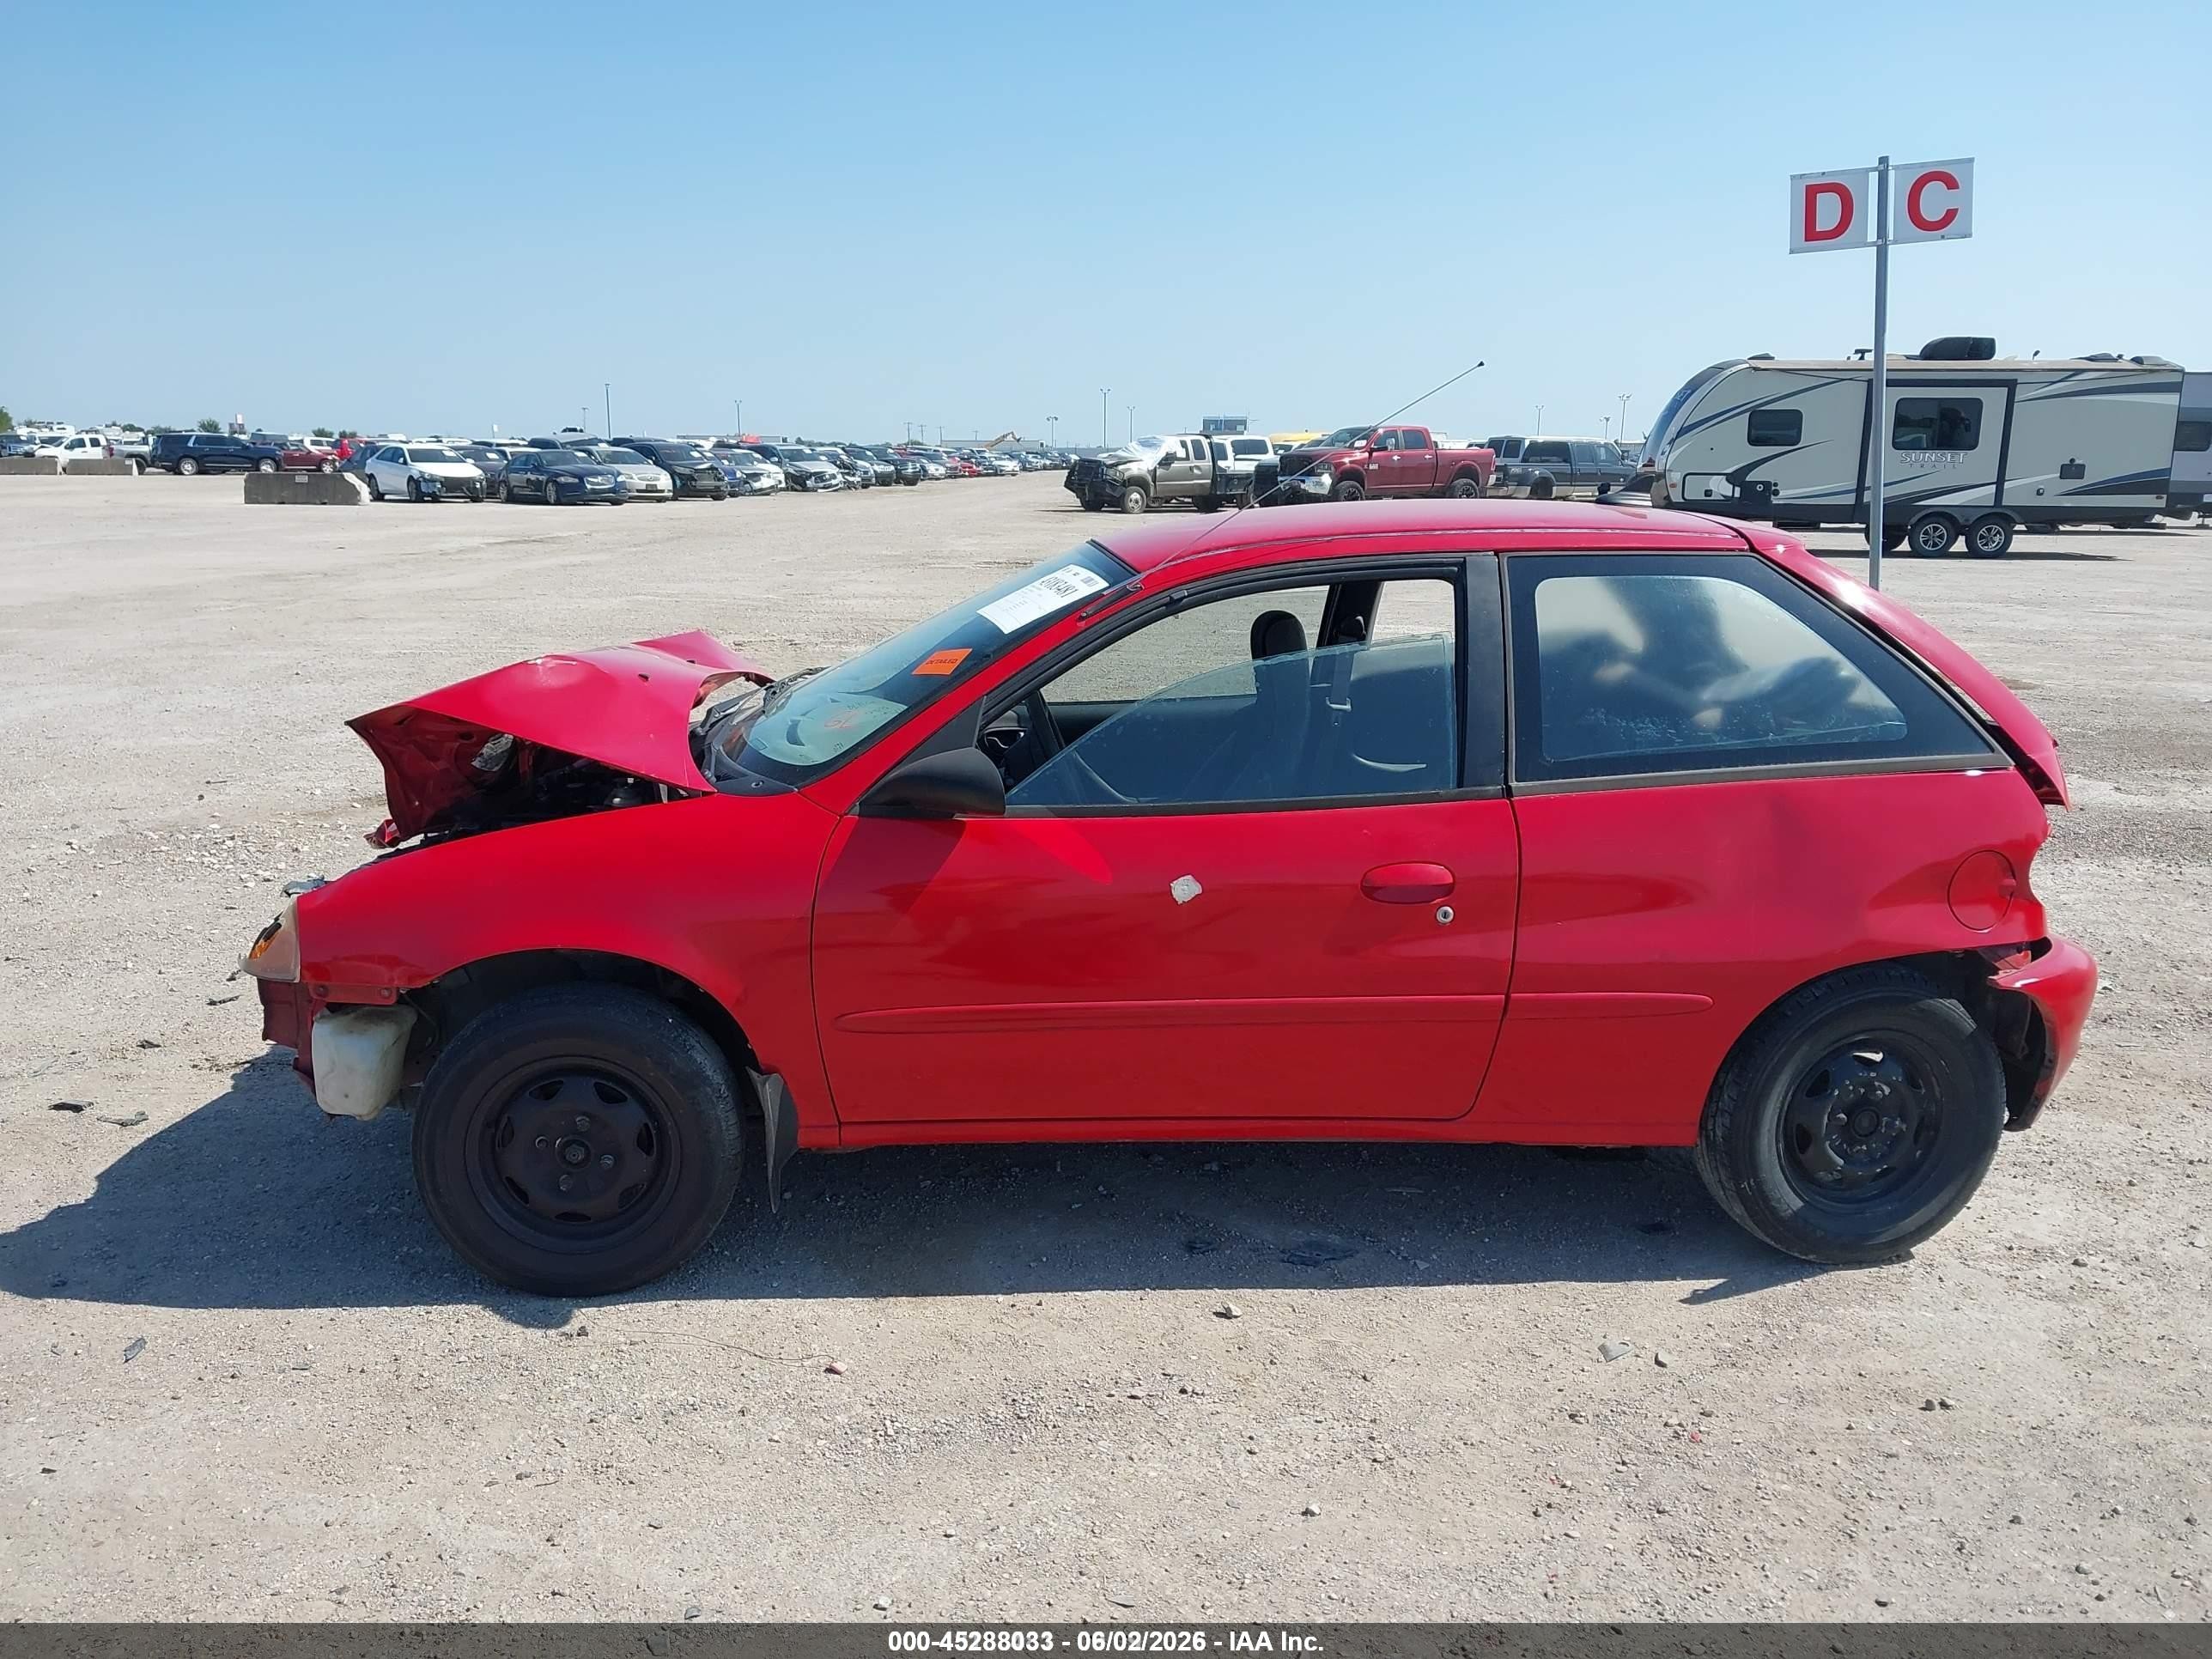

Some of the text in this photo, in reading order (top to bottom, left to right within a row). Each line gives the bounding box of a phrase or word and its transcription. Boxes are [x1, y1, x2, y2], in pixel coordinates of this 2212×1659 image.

[1803, 181, 1855, 243] D
[1907, 170, 1960, 232] C
[1899, 451, 1968, 464] SUNSET
